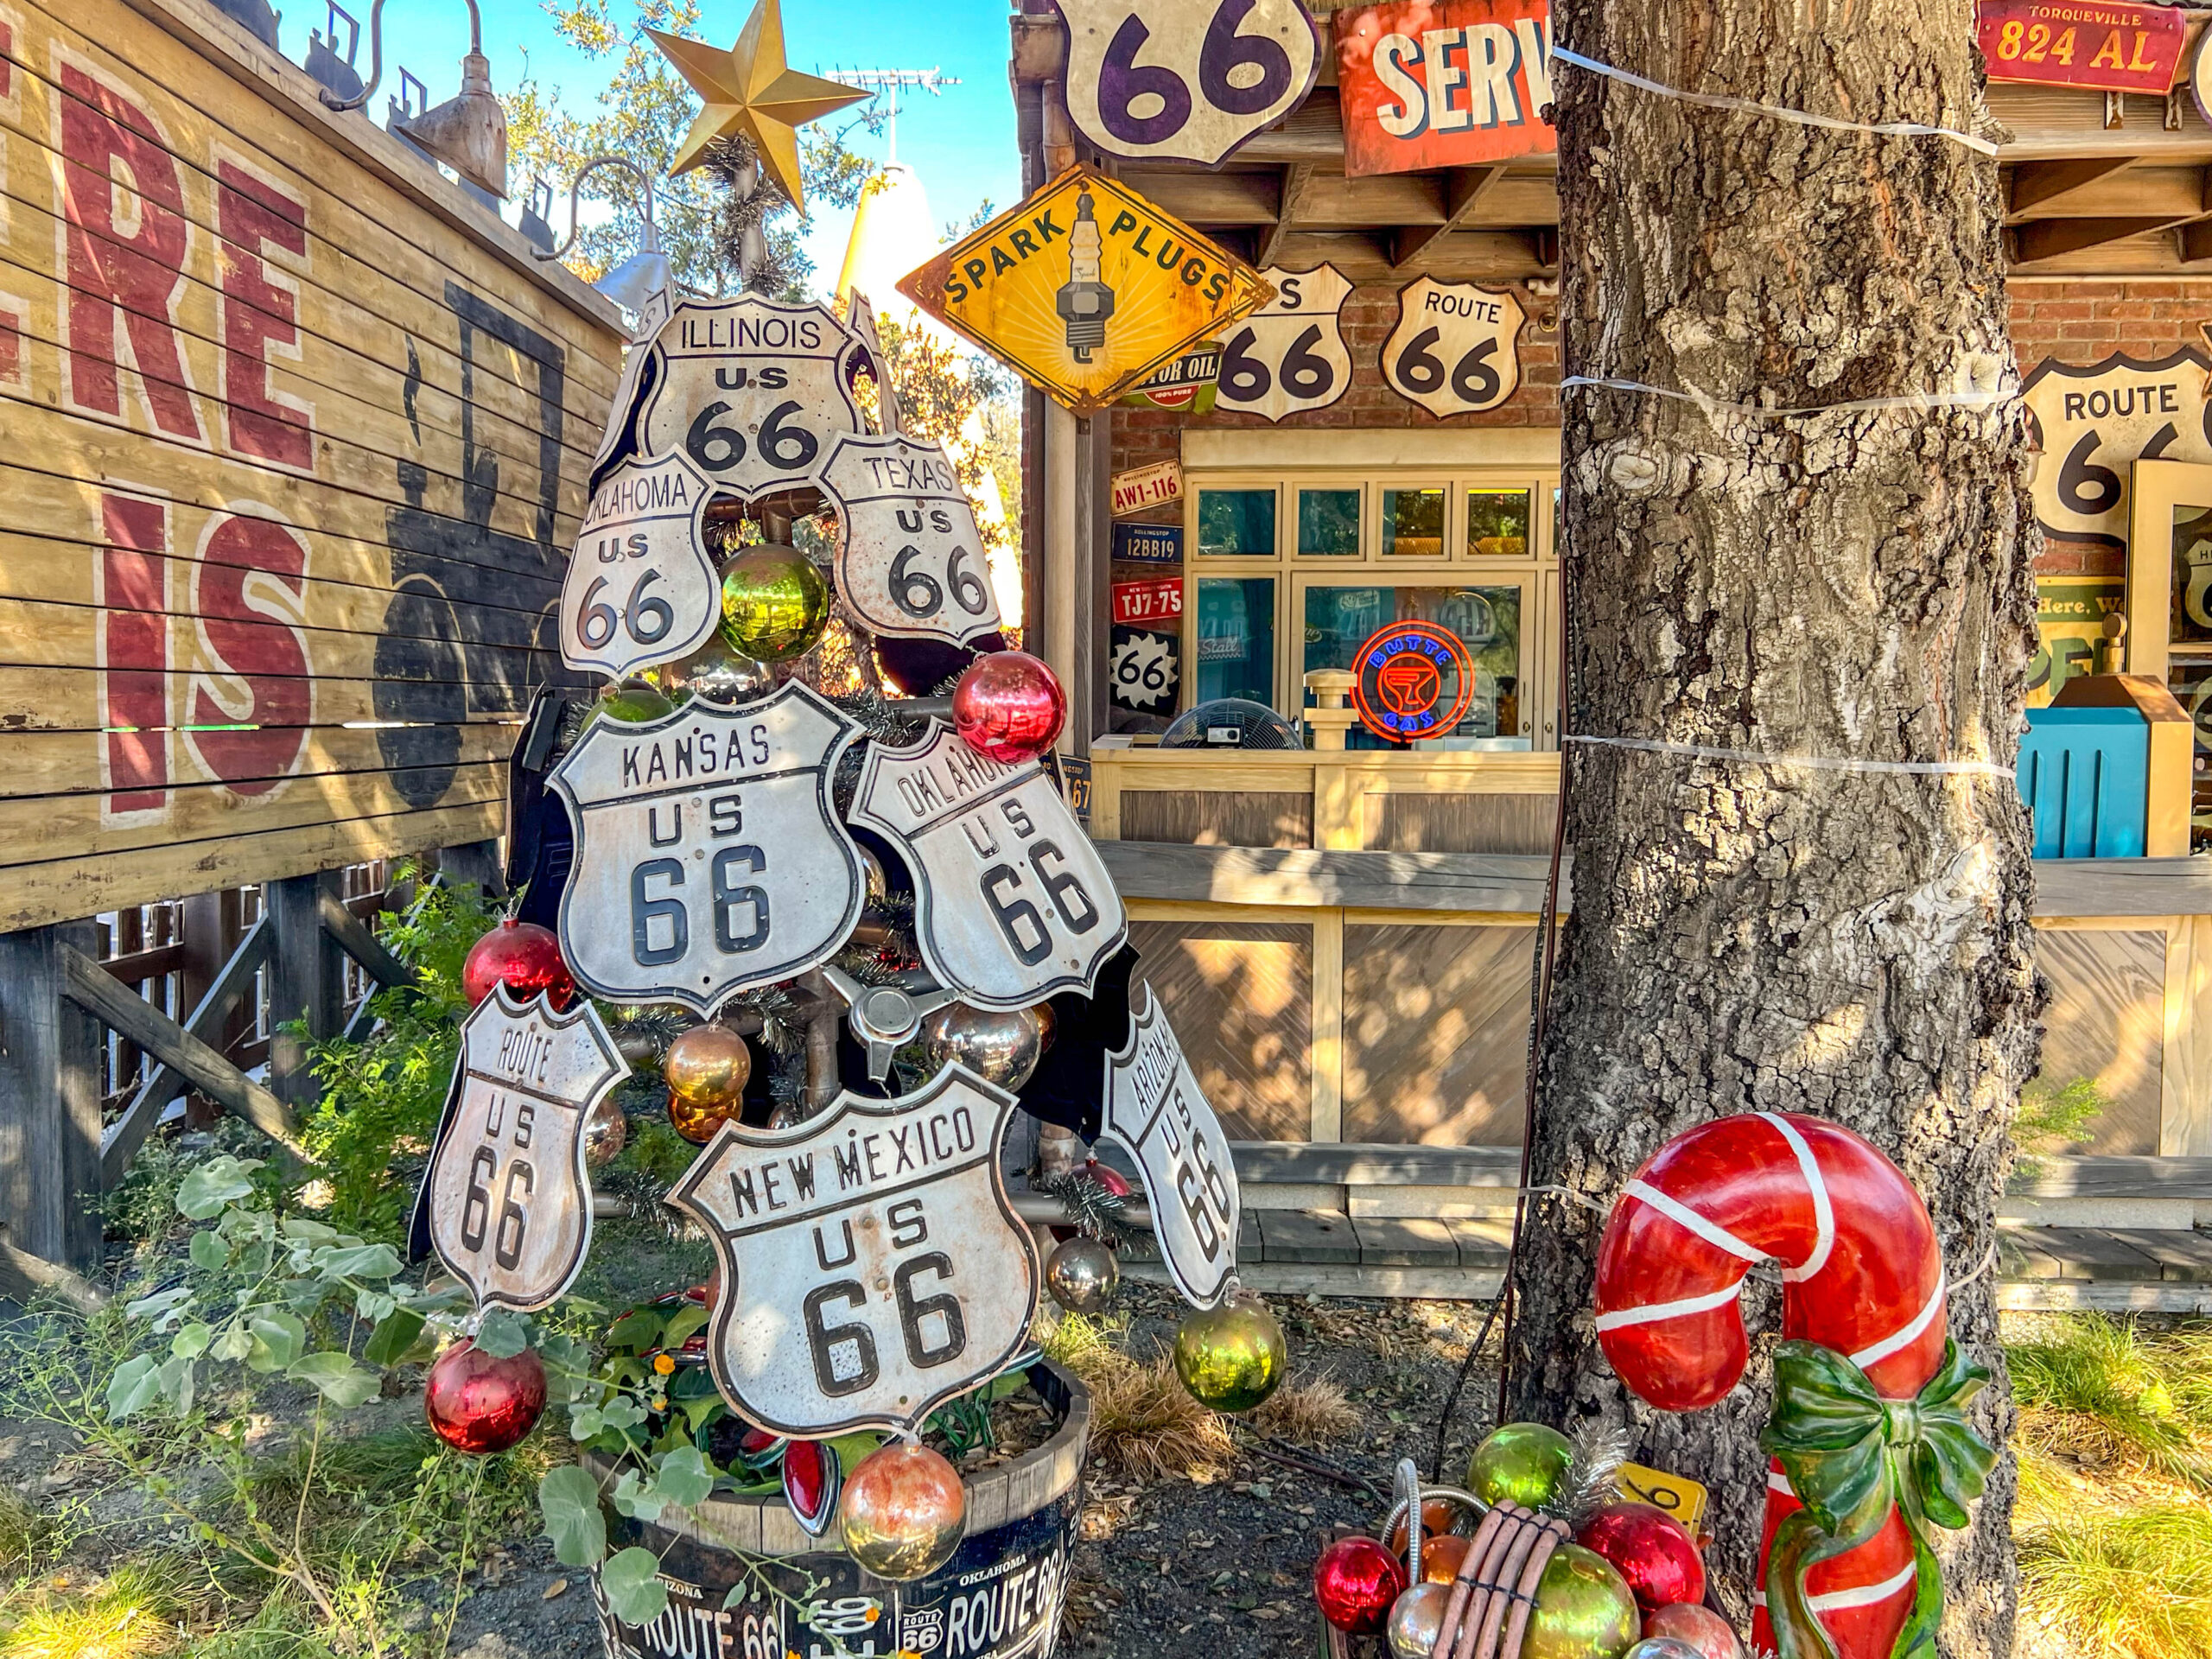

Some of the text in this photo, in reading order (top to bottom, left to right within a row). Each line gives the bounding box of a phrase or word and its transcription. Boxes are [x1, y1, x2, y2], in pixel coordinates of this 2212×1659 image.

[2029, 5, 2142, 26] TORQUEVILLE
[1098, 0, 1292, 145] 66
[1997, 20, 2158, 73] 824 AL
[0, 9, 316, 475] RE
[944, 208, 1230, 303] SPARK PLUGS
[682, 318, 822, 349] ILLINOIS
[1425, 291, 1502, 323] ROUTE
[1187, 356, 1216, 378] OIL
[1219, 323, 1333, 402] 66
[1395, 326, 1500, 404] 66
[2065, 384, 2178, 420] ROUTE
[686, 400, 818, 472] 66
[862, 455, 953, 493] TEXAS
[1115, 475, 1177, 509] AW1-116
[1127, 538, 1174, 558] 12BB19
[577, 569, 674, 651] 66
[889, 545, 988, 619] 66
[1122, 590, 1181, 616] TJ7-75
[2037, 597, 2090, 614] Here,
[98, 484, 315, 825] IS
[1118, 650, 1166, 690] 66
[1202, 636, 1237, 655] Stall
[1369, 635, 1452, 669] BUTTE
[1383, 710, 1434, 732] GAS
[622, 724, 770, 787] KANSAS
[897, 747, 1020, 817] OKLAHO
[632, 844, 770, 967] 66
[980, 838, 1100, 967] 66
[498, 1027, 553, 1084] ROUTE
[1131, 1020, 1175, 1117] ARIZONA
[729, 1107, 974, 1217] NEW MEXICO
[461, 1146, 534, 1271] 66
[1177, 1127, 1230, 1263] 66
[803, 1252, 967, 1399] 66
[959, 1554, 1027, 1586] OKLAHOMA
[904, 1613, 938, 1626] ROUTE
[946, 1566, 1036, 1659] ROUTE
[1036, 1548, 1058, 1614] 66
[743, 1613, 779, 1659] 66
[903, 1626, 938, 1651] 66
